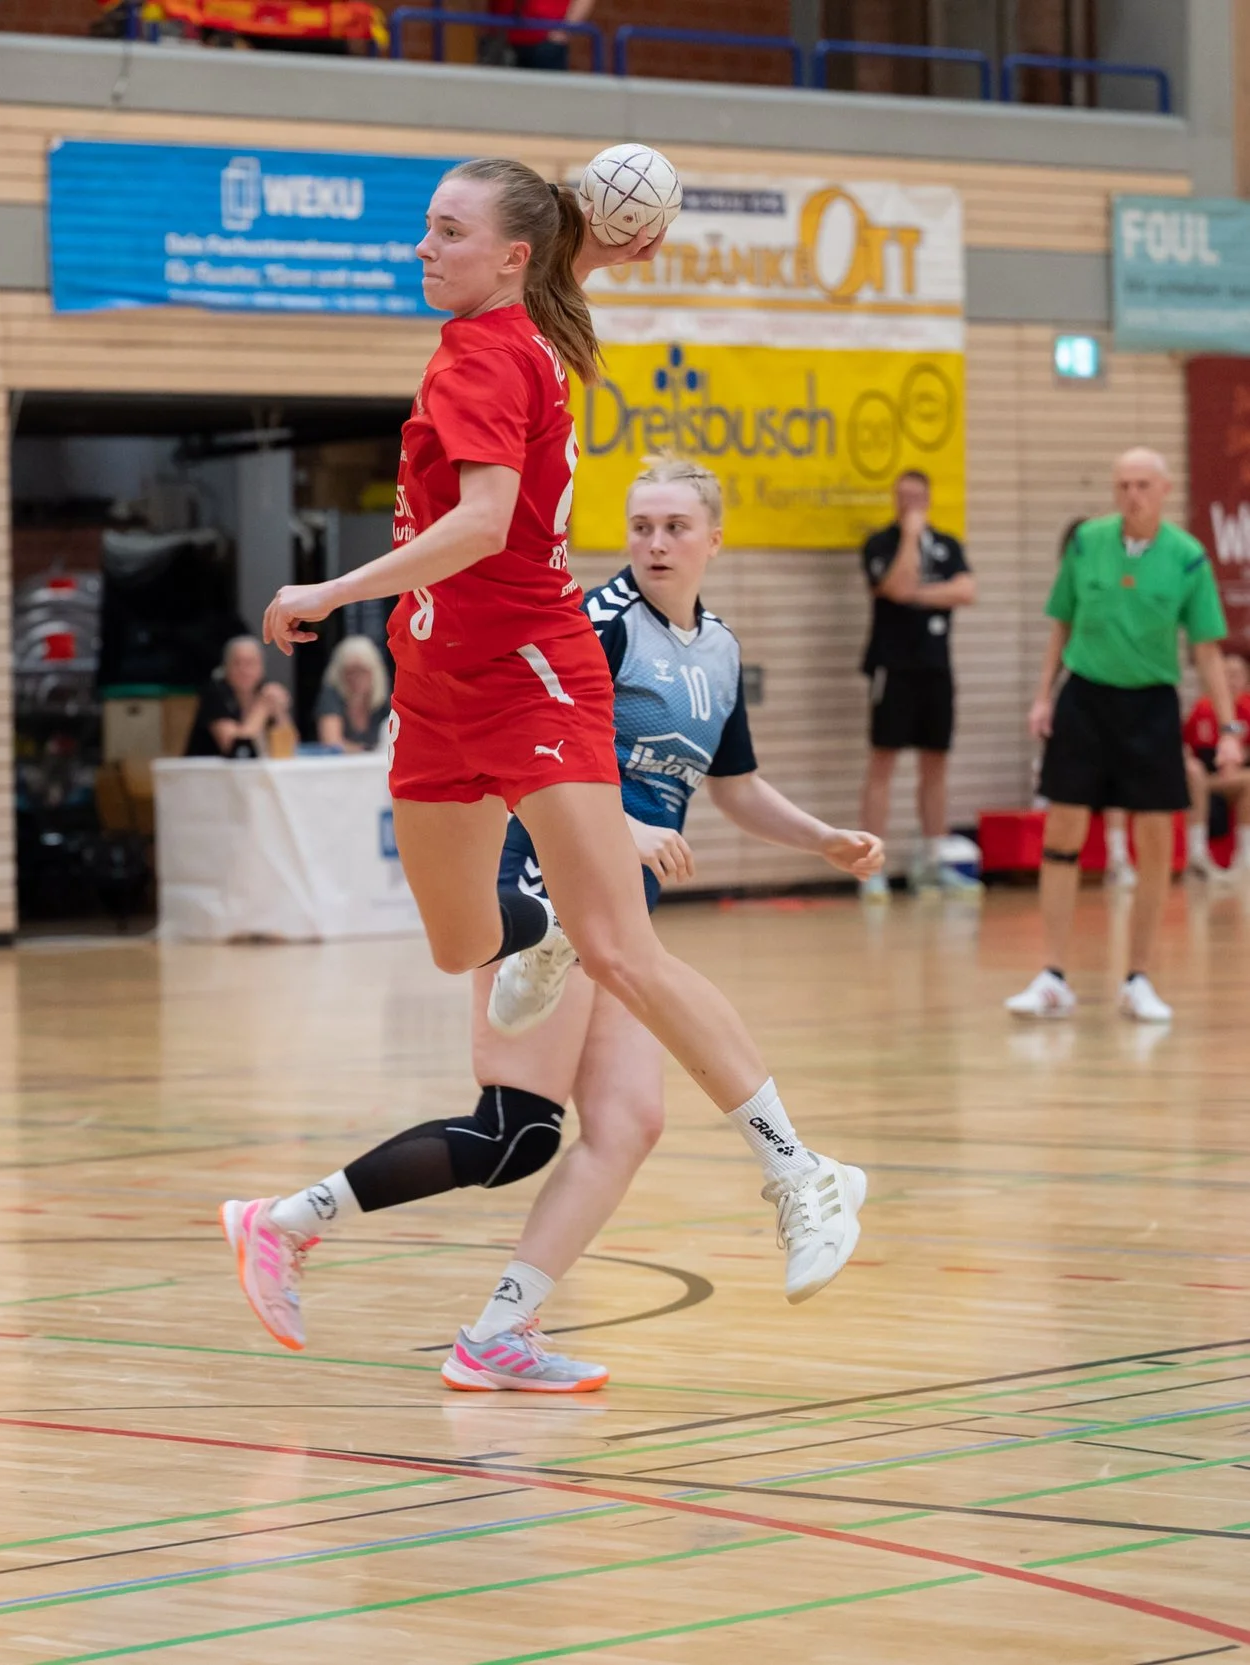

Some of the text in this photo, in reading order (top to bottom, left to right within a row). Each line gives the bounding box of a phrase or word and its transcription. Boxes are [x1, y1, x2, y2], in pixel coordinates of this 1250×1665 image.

[262, 174, 364, 219] WEKU
[1121, 209, 1220, 265] FOUL
[680, 664, 711, 721] 10
[749, 1116, 785, 1145] CRAFT
